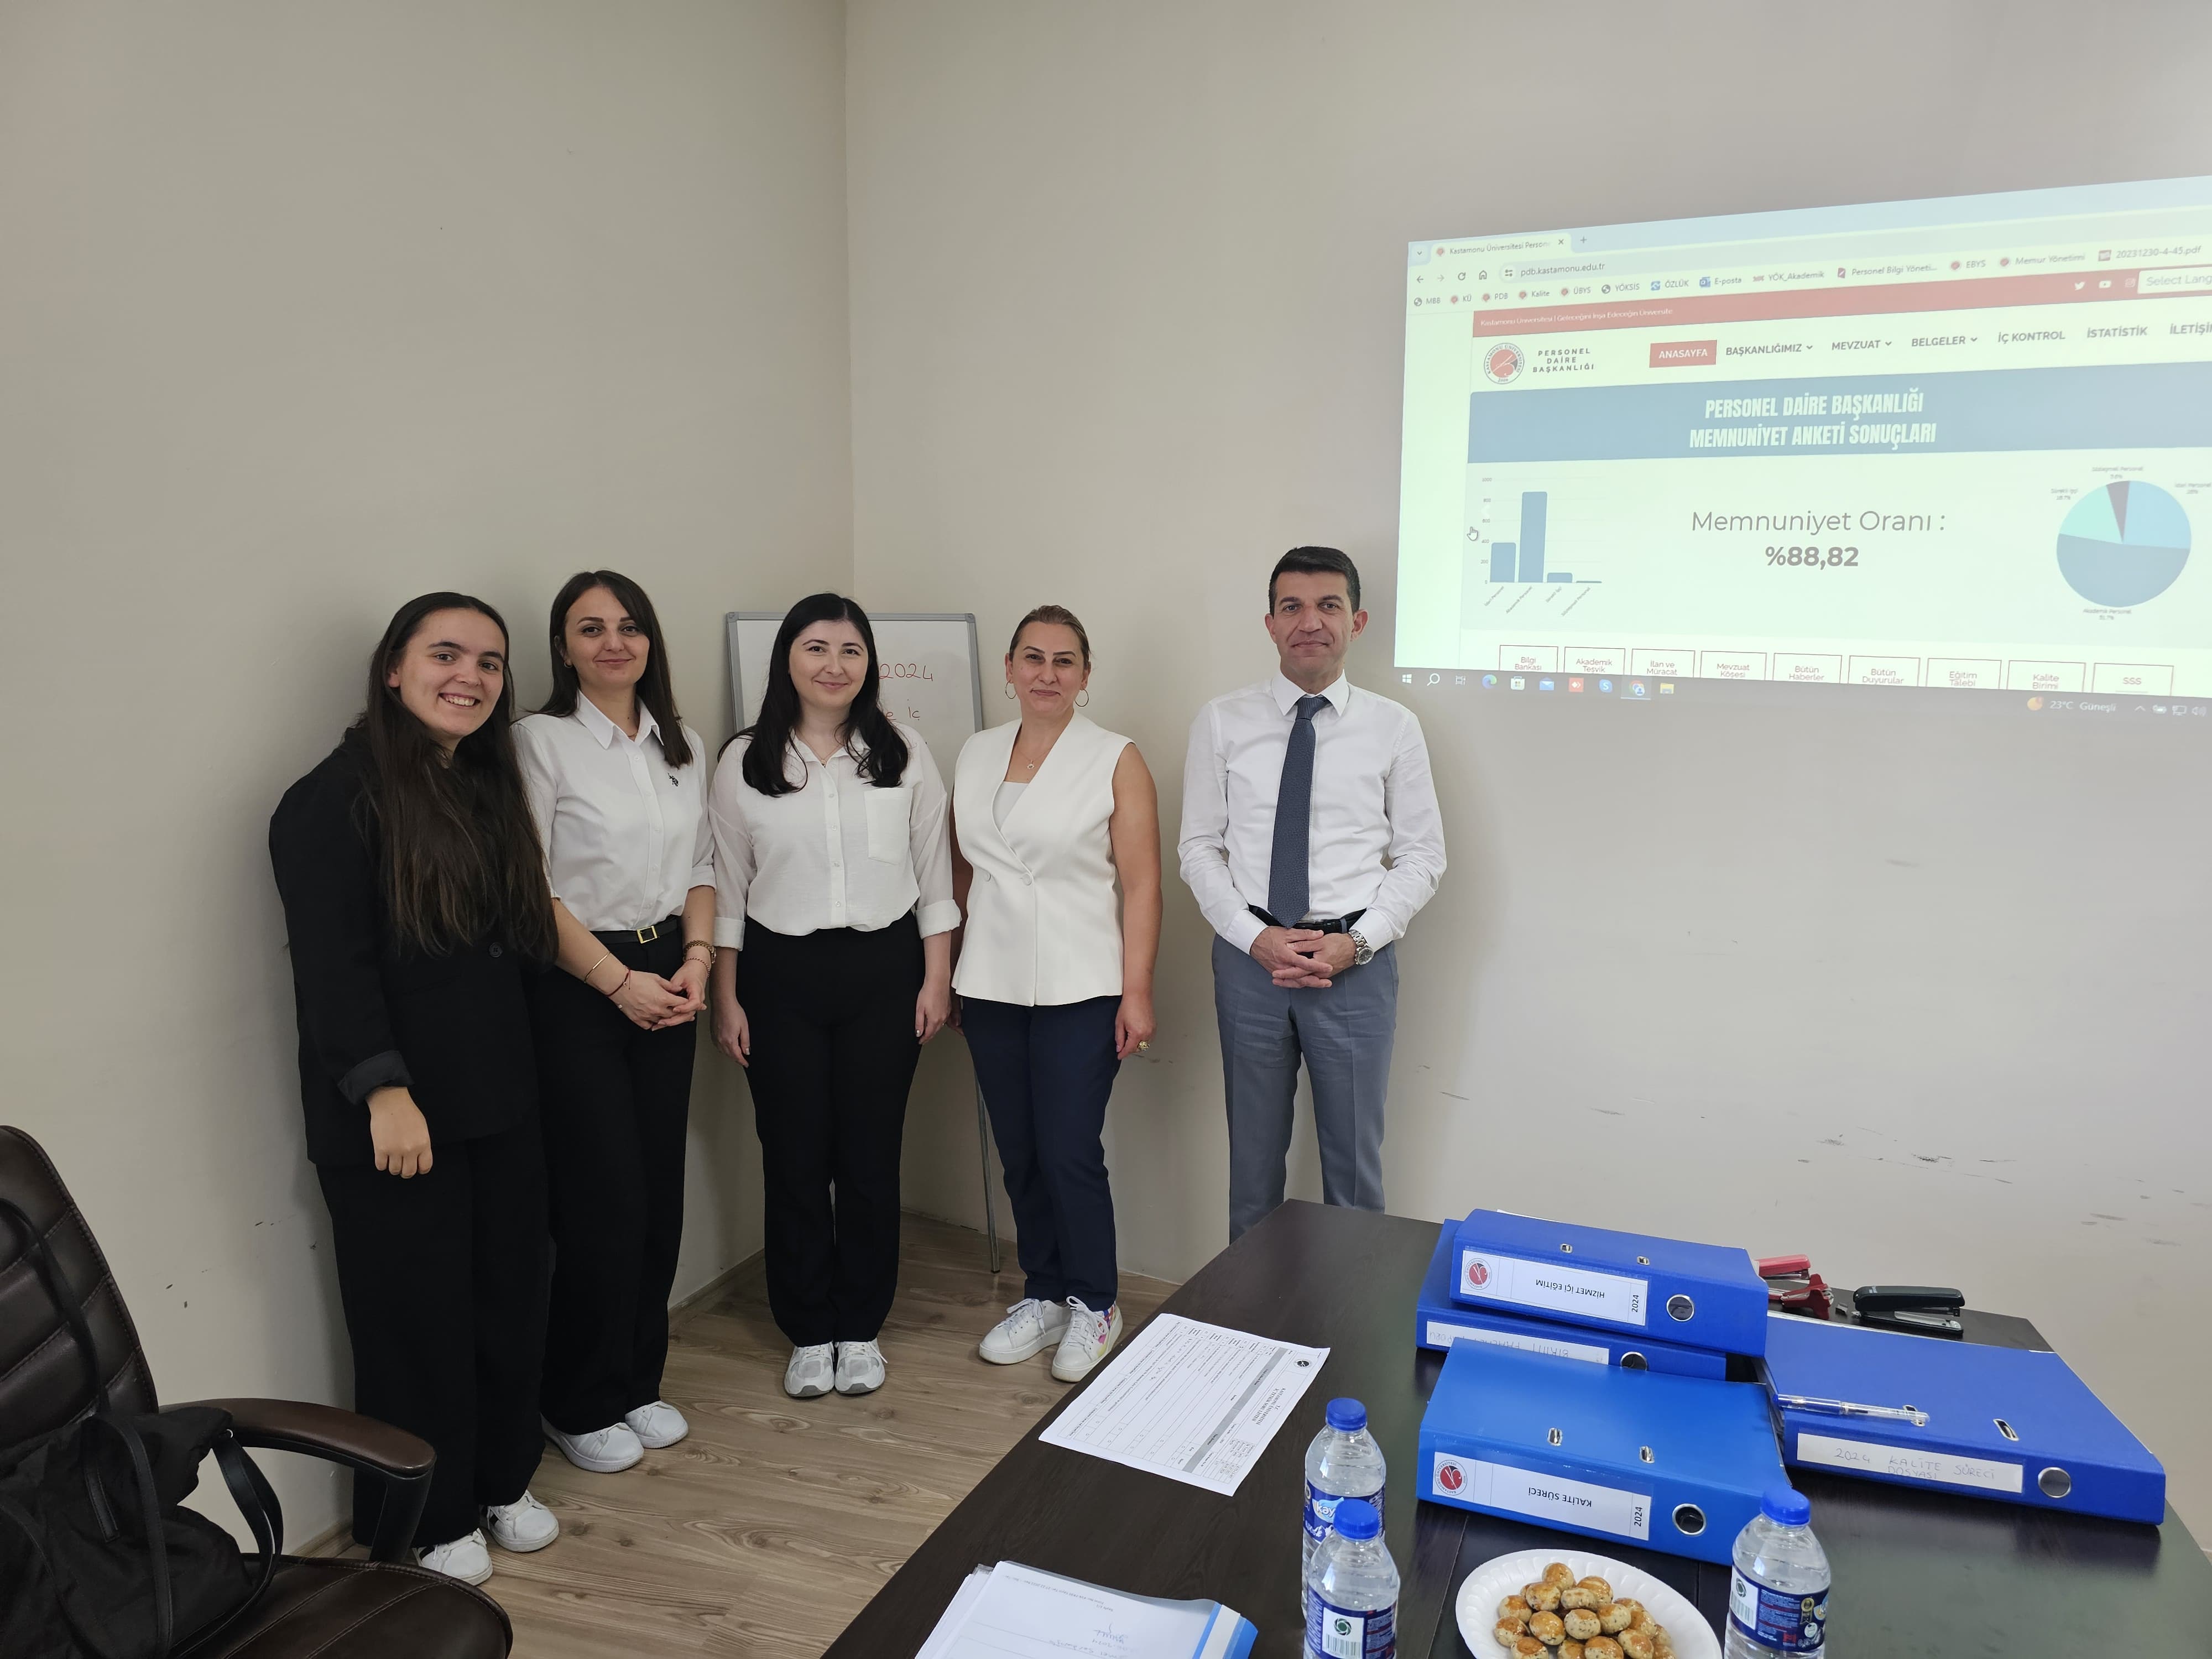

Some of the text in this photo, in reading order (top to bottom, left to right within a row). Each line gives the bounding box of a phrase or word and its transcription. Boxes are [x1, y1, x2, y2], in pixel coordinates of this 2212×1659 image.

[1966, 260, 1986, 268] EBYS
[2015, 257, 2046, 265] Memur
[1520, 263, 1605, 277] pdb.kastamonu.edu.tr
[1852, 267, 1884, 275] Personel
[1887, 265, 1903, 275] Bilgi
[1665, 279, 1689, 288] ÖZLÜK
[1715, 277, 1742, 286] E-posta
[2146, 275, 2182, 286] Select
[1480, 318, 1515, 326] Kastamonu
[2087, 325, 2148, 338] İSTATİSTİK
[2169, 322, 2212, 336] İLETİŞİ
[1911, 336, 1966, 347] BELGELER
[1998, 331, 2065, 345] İÇ KONTROL
[1725, 343, 1802, 357] BAŞKANLIĞIMIZ
[1832, 340, 1881, 351] MEVZUAT
[1538, 348, 1591, 357] PERSONEL
[1659, 348, 1708, 359] ANASAYFA
[1533, 363, 1594, 373] BAŞKANLIĞI
[1705, 387, 1924, 420] PERSONEL DAİRE BAŞKANLIĞI
[1689, 421, 1937, 450] MEMNUNİYET ANKETİ SONUÇLARI
[1692, 510, 1851, 535] Memnuniyet
[1860, 510, 1931, 531] Oranı
[1765, 546, 1859, 570] %88,82
[1521, 656, 1536, 665] Bilgi
[1576, 658, 1613, 666] Akademik
[879, 663, 933, 681] 2024
[1794, 665, 1819, 674] Bütün
[1871, 668, 1896, 676] Bütün
[1949, 670, 1977, 680] Eğitim
[1788, 673, 1824, 681] Haberler
[1863, 676, 1904, 685] Duyurular
[2033, 674, 2059, 682] Kalite
[2123, 677, 2142, 685] SSS
[1950, 679, 1976, 687] Talebi
[2032, 681, 2059, 690] Birimi
[2049, 700, 2116, 712] 23°C Güneşli
[1536, 1279, 1605, 1298] HİZMET İÇİ EĞİTİM
[1631, 1295, 1640, 1313] 2024
[1890, 1455, 1942, 1471] KALİTE
[1528, 1487, 1592, 1507] KALİTE SÜRECİ
[1634, 1506, 1642, 1527] 2024
